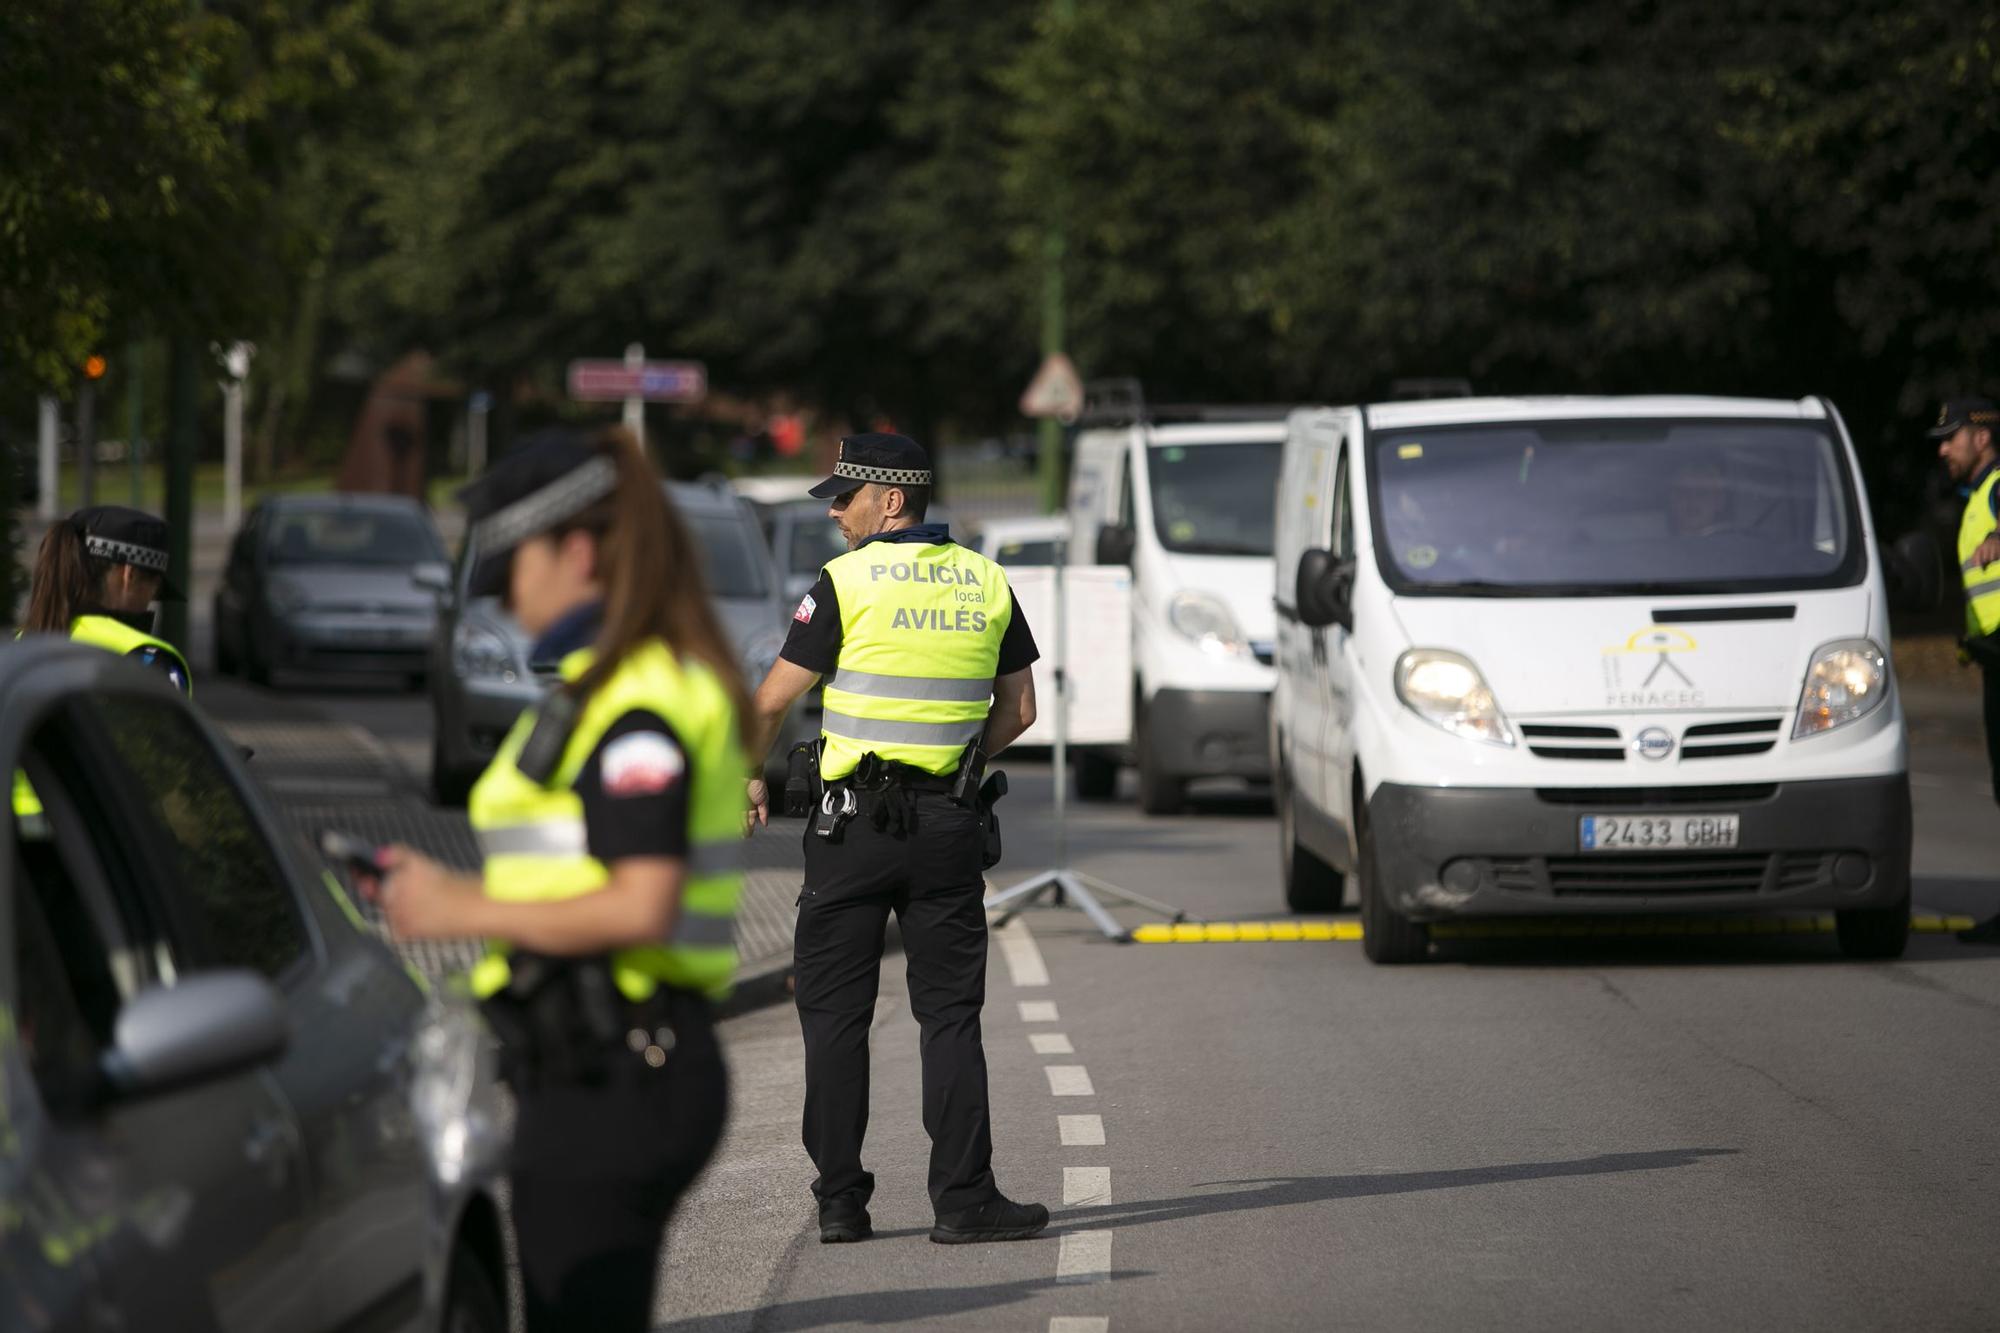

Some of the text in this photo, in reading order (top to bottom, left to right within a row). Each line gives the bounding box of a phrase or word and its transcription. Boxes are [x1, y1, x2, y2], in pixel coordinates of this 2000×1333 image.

[870, 562, 982, 586] POLICÍA
[954, 588, 985, 603] local
[891, 605, 988, 632] AVILÉS
[1603, 818, 1734, 846] 2433 GBH
